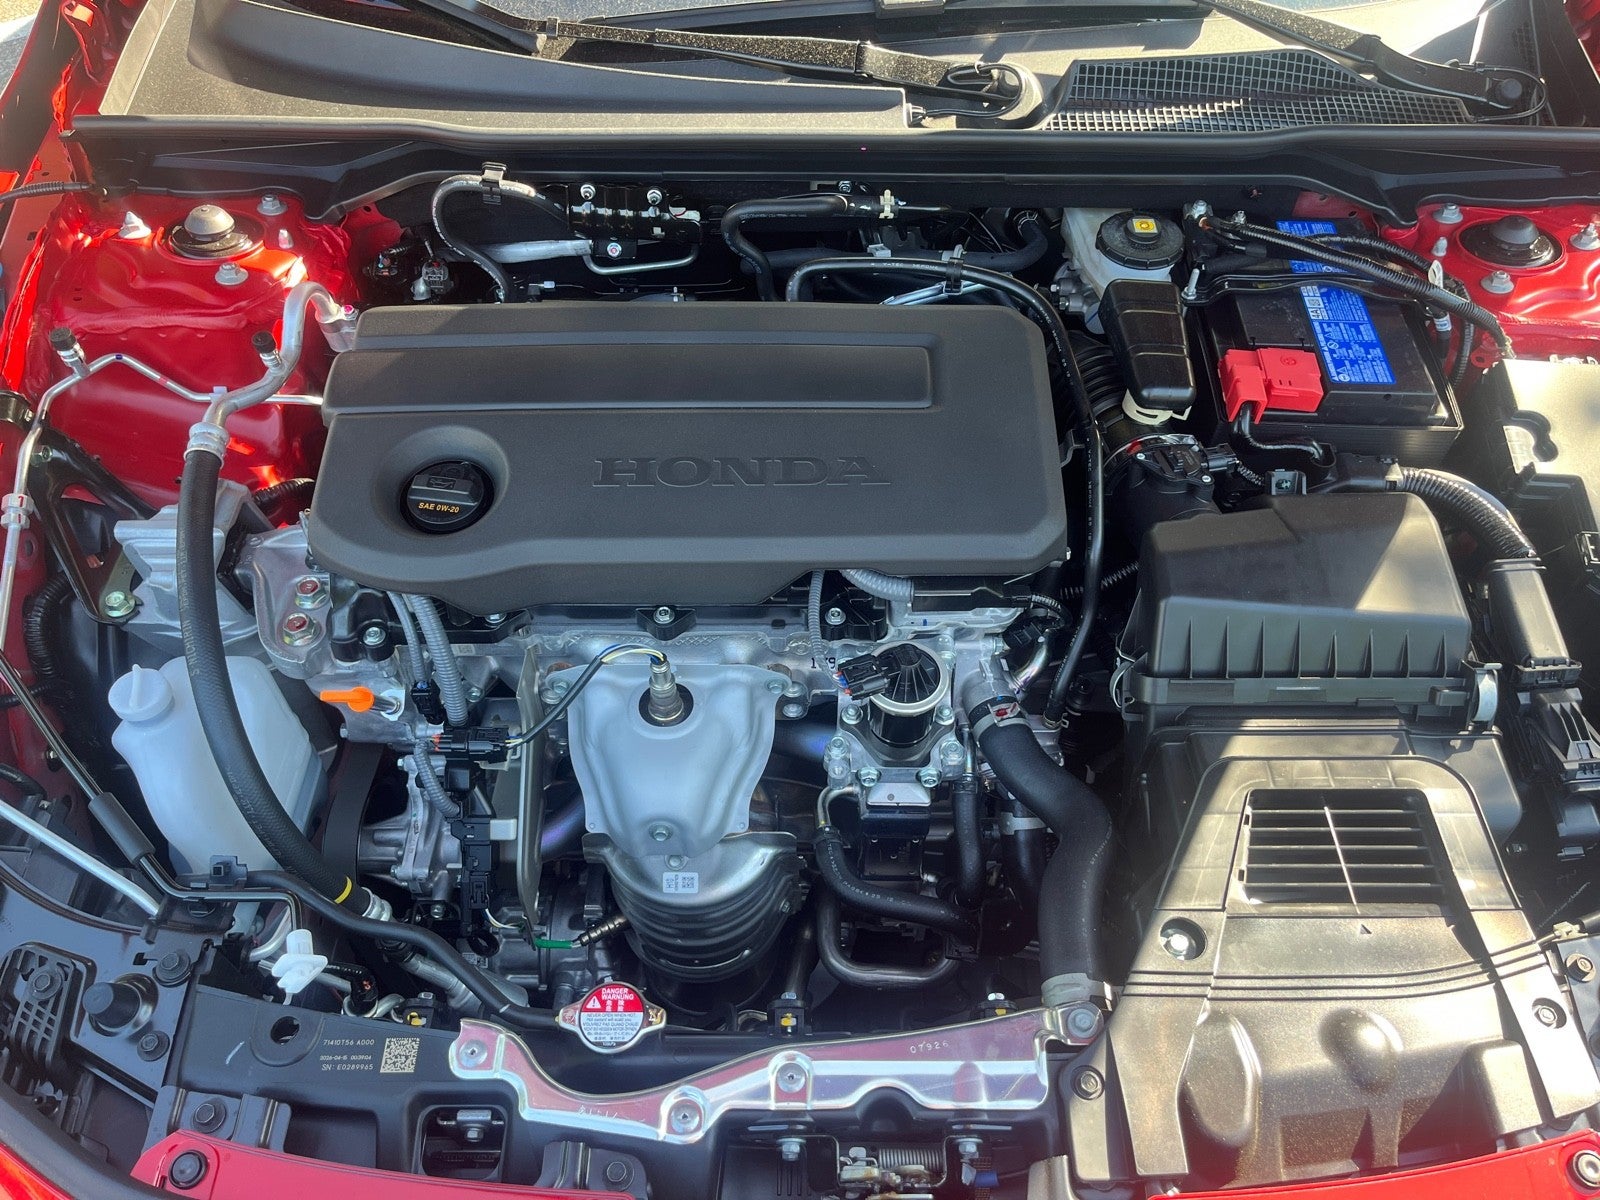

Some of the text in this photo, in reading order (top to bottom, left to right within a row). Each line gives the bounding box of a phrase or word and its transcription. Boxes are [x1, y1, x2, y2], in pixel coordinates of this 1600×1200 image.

[591, 456, 892, 488] HONDA
[418, 502, 460, 513] SAE 0W-20
